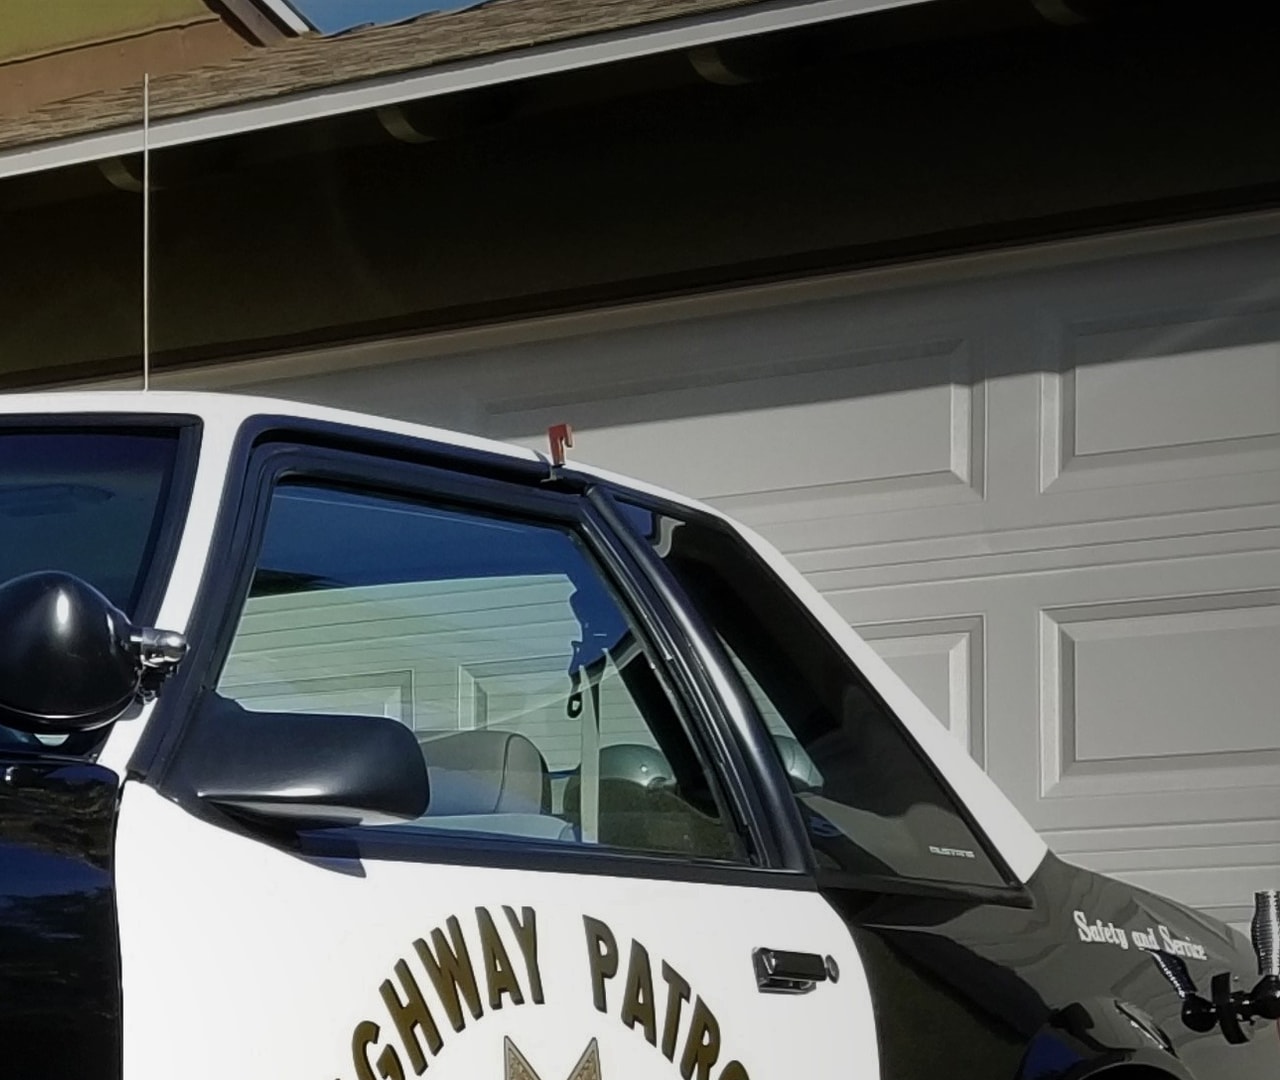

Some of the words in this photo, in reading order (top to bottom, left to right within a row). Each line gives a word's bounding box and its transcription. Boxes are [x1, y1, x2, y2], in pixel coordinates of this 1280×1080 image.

[1073, 910, 1129, 949] Safety
[1132, 928, 1160, 951] and
[1158, 925, 1208, 960] Service
